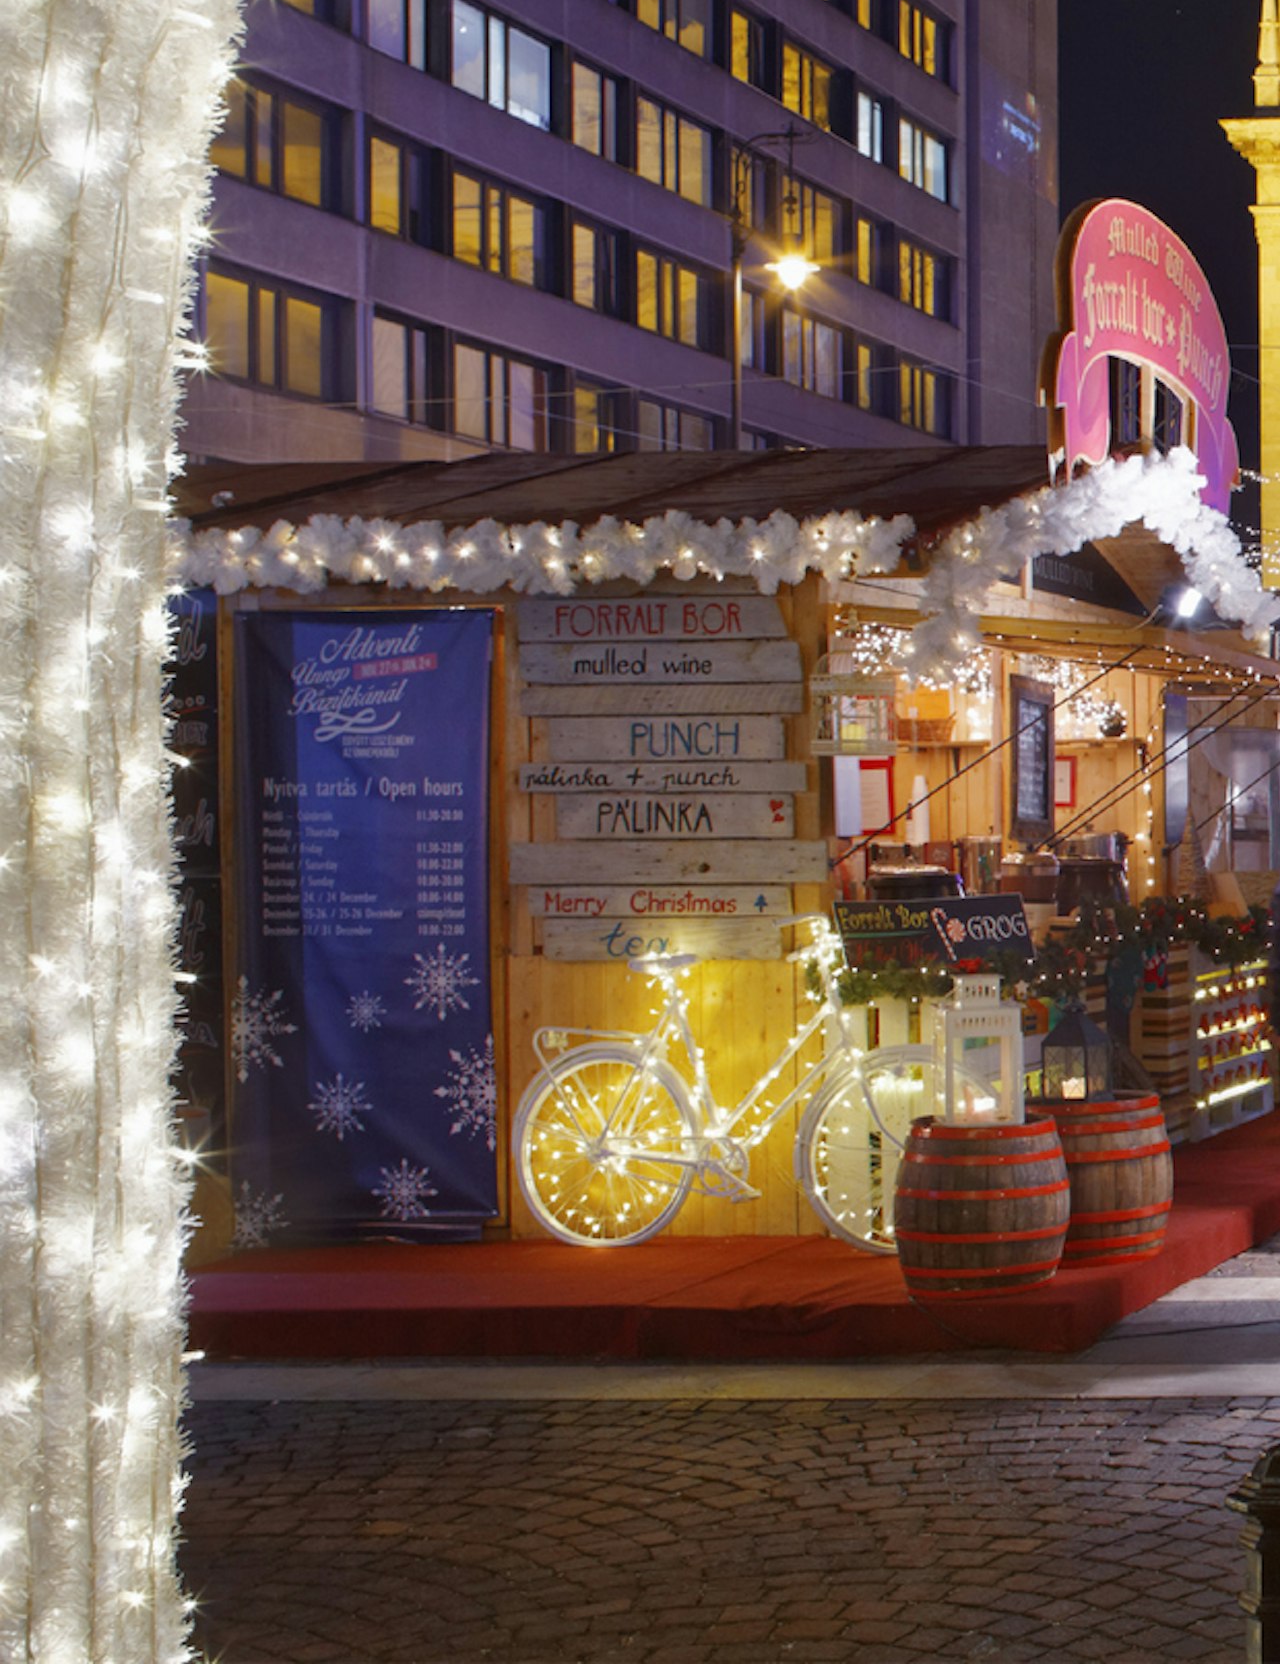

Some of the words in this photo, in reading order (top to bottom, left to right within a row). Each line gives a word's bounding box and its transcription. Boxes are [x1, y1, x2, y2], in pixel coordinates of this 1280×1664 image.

[1108, 217, 1159, 266] Mulled
[1165, 242, 1201, 313] Wine
[1083, 263, 1138, 348] Forralt
[1142, 279, 1165, 347] bor
[1177, 303, 1223, 410] Punch
[555, 603, 667, 636] FORRALT
[683, 603, 742, 635] BOR
[320, 624, 424, 663] Adventi
[574, 648, 646, 675] mulled
[663, 653, 712, 675] wine
[630, 722, 739, 757] PUNCH
[263, 777, 308, 803] Nyitva
[316, 778, 357, 796] tartás
[379, 777, 416, 802] Open
[424, 777, 464, 796] hours
[526, 764, 613, 787] pálinka
[663, 766, 739, 792] punch
[597, 799, 713, 833] PÁLINKA
[544, 892, 607, 917] Merry
[630, 889, 737, 914] Christmas
[895, 903, 929, 929] Bor
[600, 922, 670, 958] tea
[967, 912, 1027, 942] GROG
